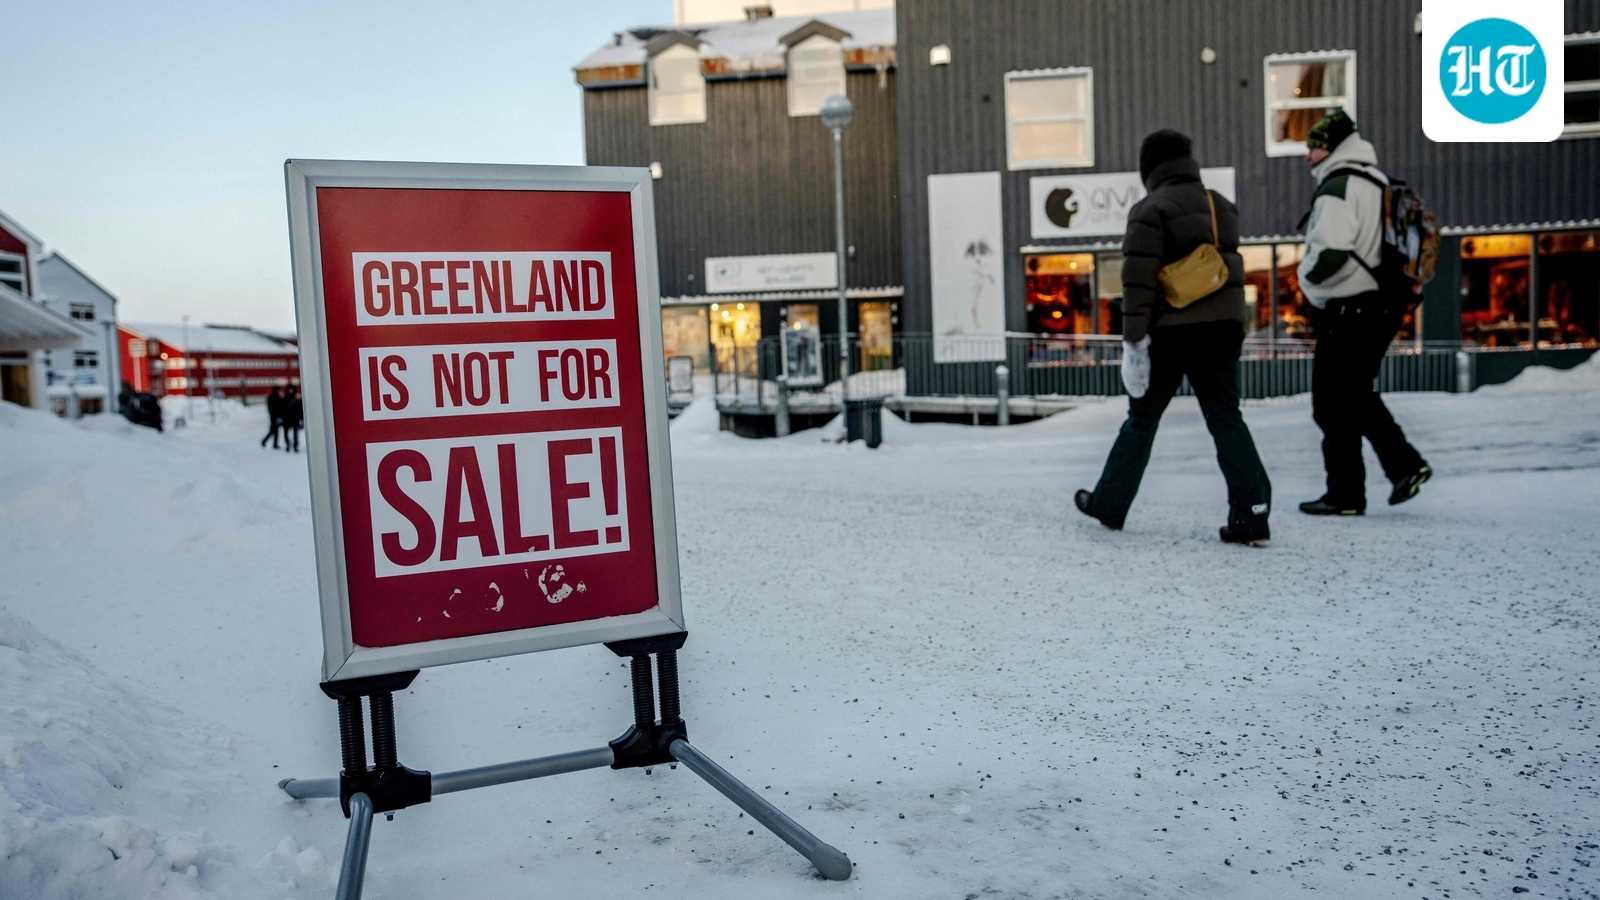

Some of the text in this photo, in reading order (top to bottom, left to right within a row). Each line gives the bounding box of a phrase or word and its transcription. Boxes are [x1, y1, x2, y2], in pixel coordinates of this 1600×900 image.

[363, 259, 606, 317] GREENLAND
[368, 348, 612, 411] IS NOT FOR
[376, 436, 622, 566] SALE!
